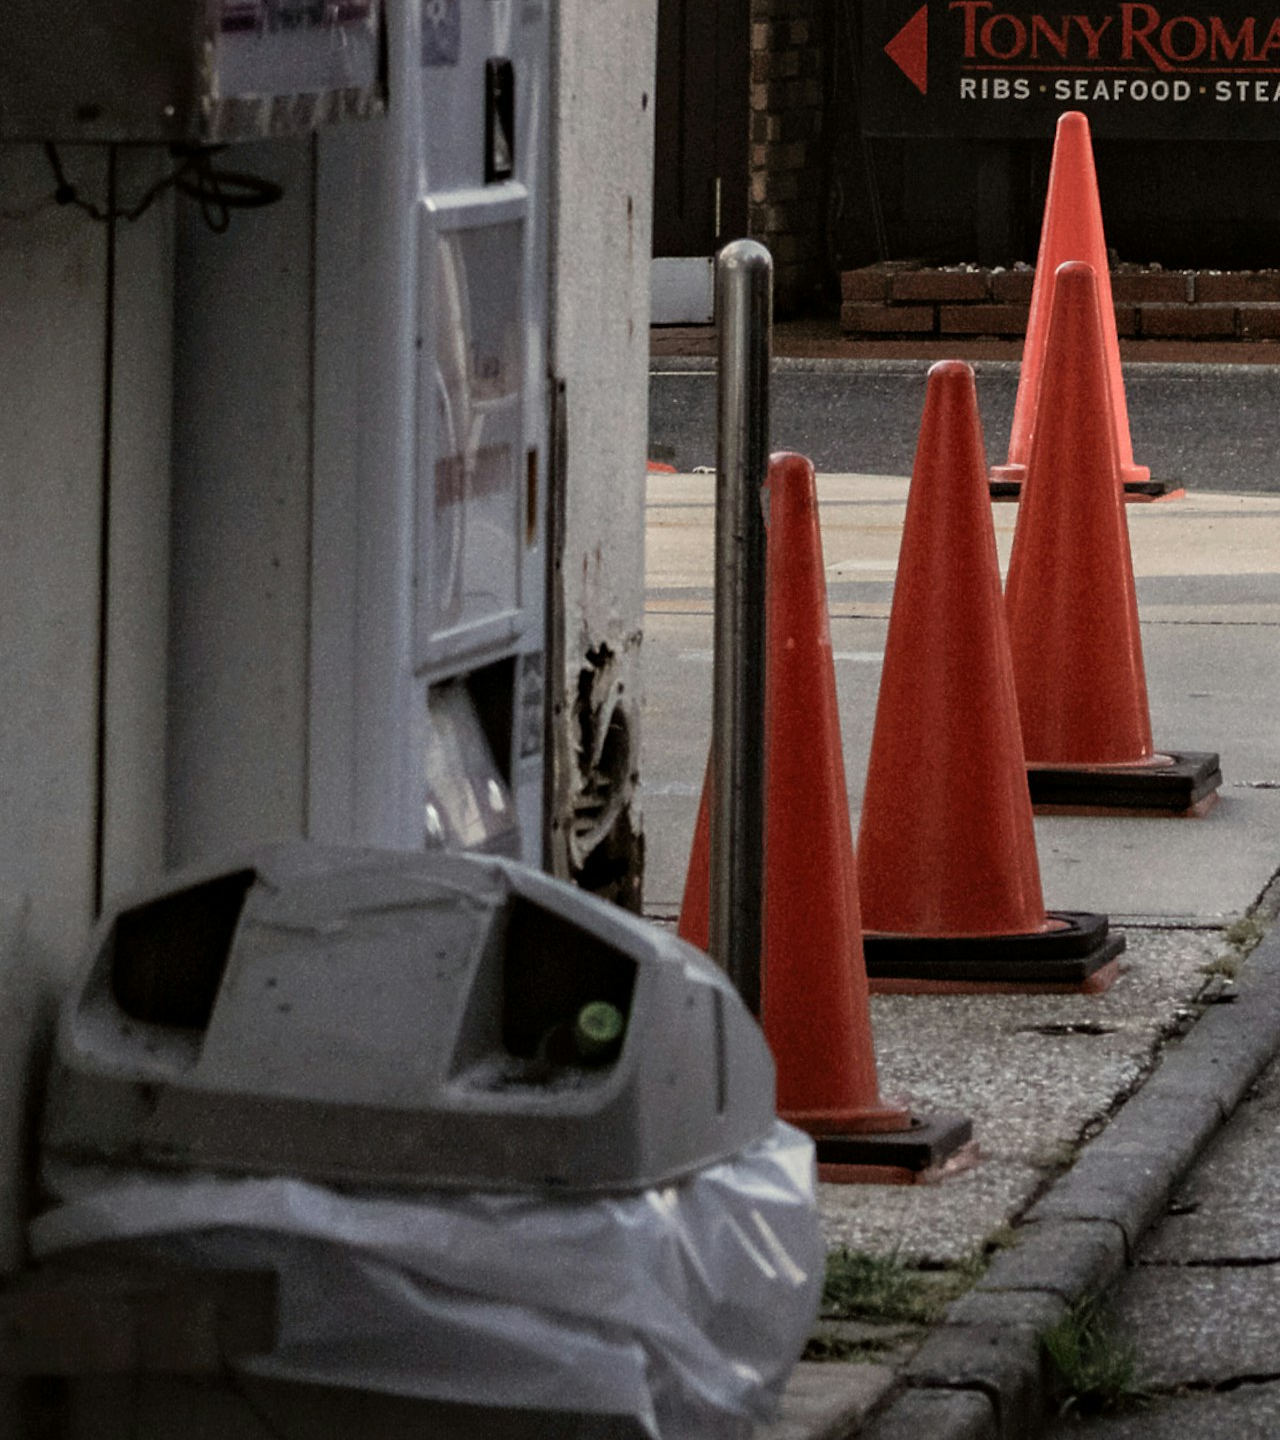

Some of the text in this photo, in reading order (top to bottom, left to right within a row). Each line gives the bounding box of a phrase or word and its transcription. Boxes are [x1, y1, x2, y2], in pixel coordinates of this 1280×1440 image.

[948, 0, 1113, 60] TONY
[960, 79, 1031, 99] RIBS
[1054, 79, 1191, 101] SEAFOOD
